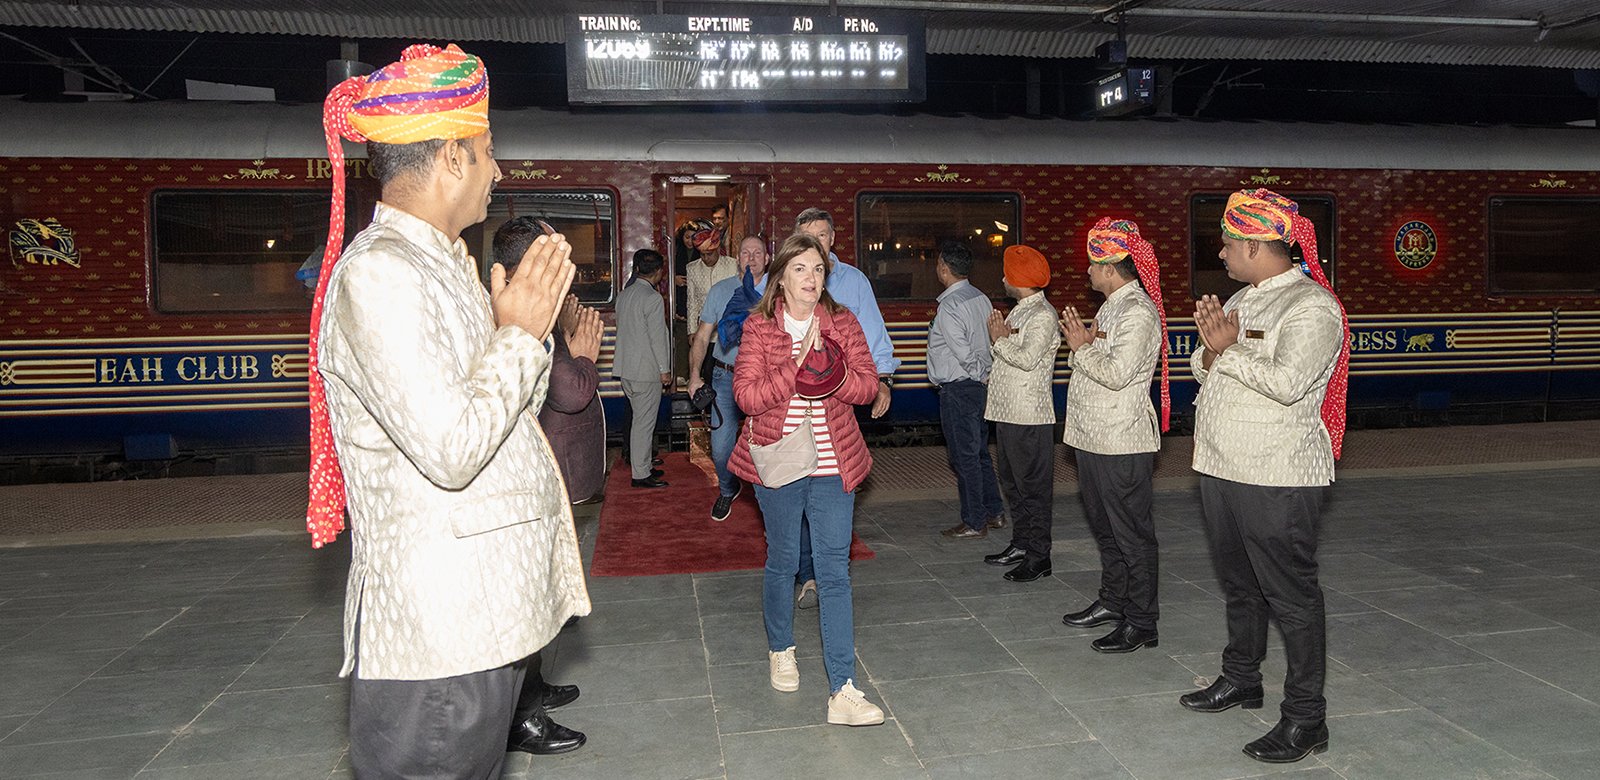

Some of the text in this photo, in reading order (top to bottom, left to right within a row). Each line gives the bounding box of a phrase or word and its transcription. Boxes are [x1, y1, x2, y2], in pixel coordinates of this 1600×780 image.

[579, 16, 619, 31] TRAIN
[793, 17, 813, 31] A/D
[1142, 69, 1151, 80] 12
[176, 355, 260, 381] CLUB
